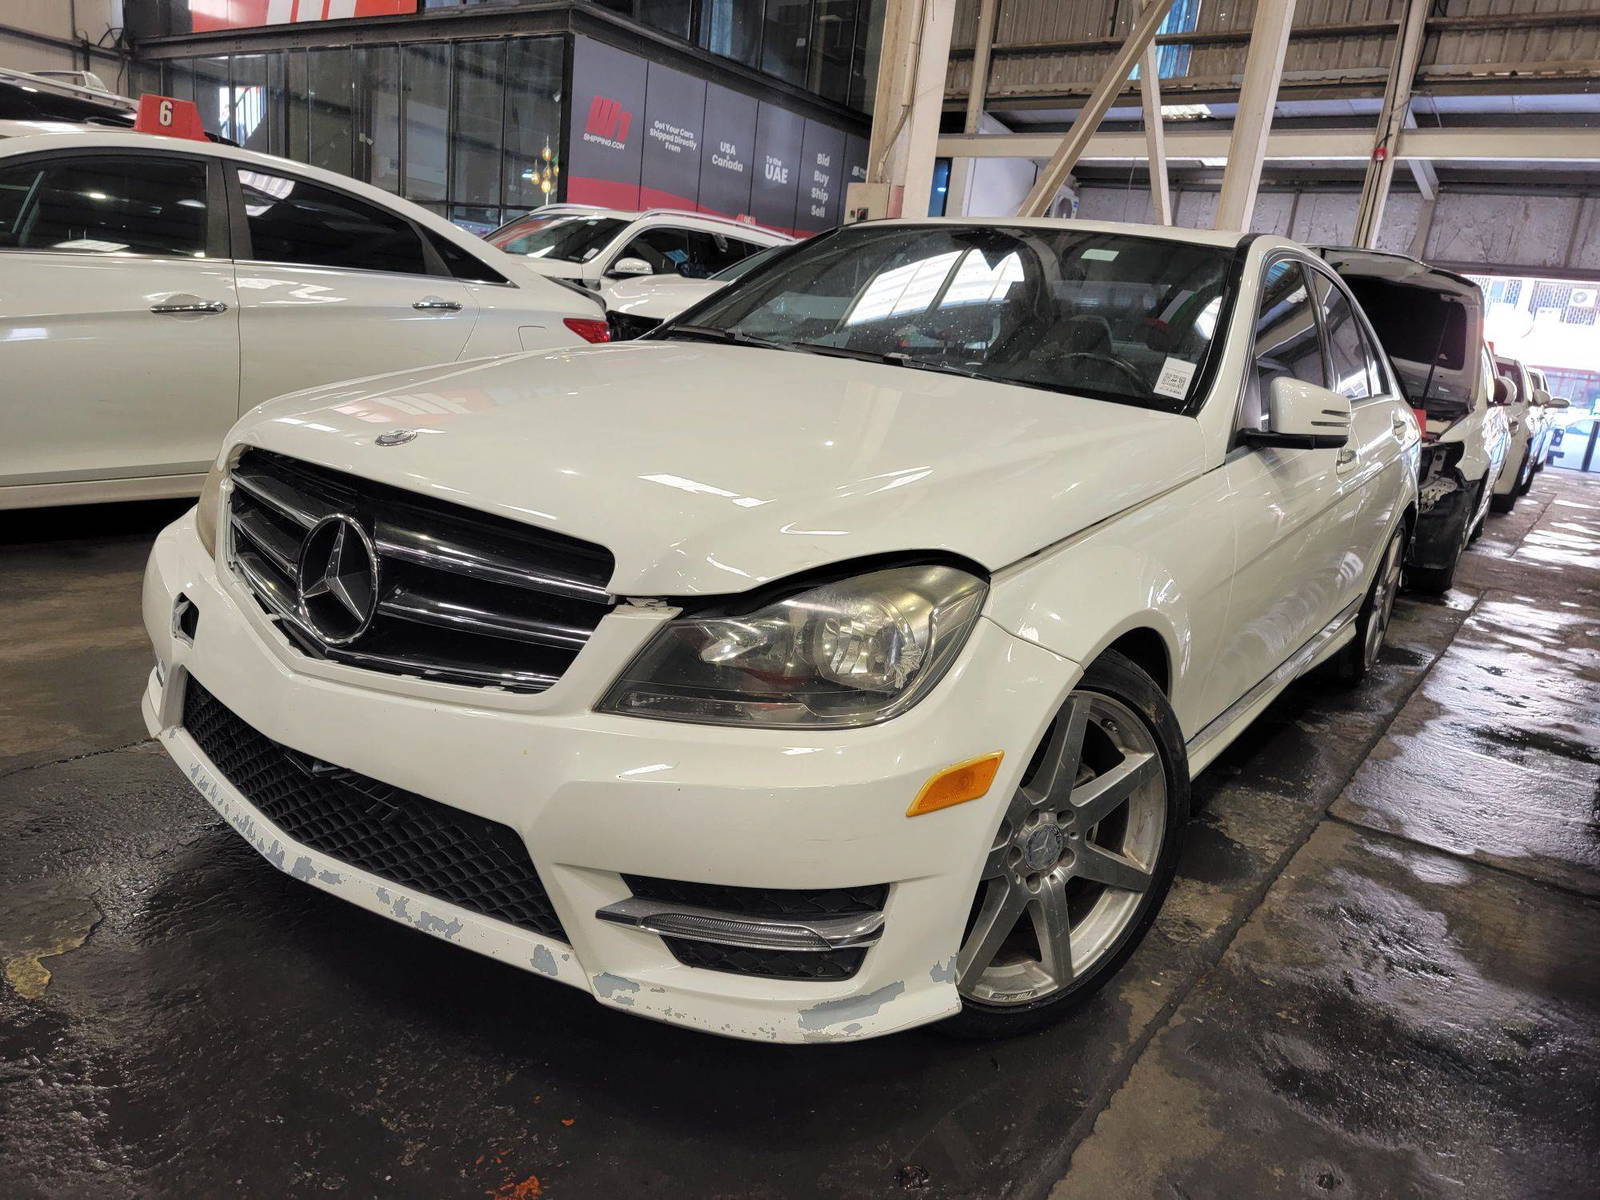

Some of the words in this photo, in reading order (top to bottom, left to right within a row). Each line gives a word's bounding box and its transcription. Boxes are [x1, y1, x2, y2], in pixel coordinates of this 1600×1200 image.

[160, 100, 173, 126] 6
[650, 128, 674, 142] Shipped
[674, 135, 697, 151] Directly
[665, 123, 680, 135] Your
[680, 128, 694, 139] Cars
[583, 132, 625, 150] SHIPPING.COM
[720, 141, 736, 156] USA
[711, 154, 744, 173] Canada
[766, 155, 773, 164] To
[816, 153, 830, 167] Bid
[765, 163, 789, 184] UAE
[814, 169, 830, 188] Buy
[811, 187, 829, 205] Ship
[810, 204, 826, 218] Sell
